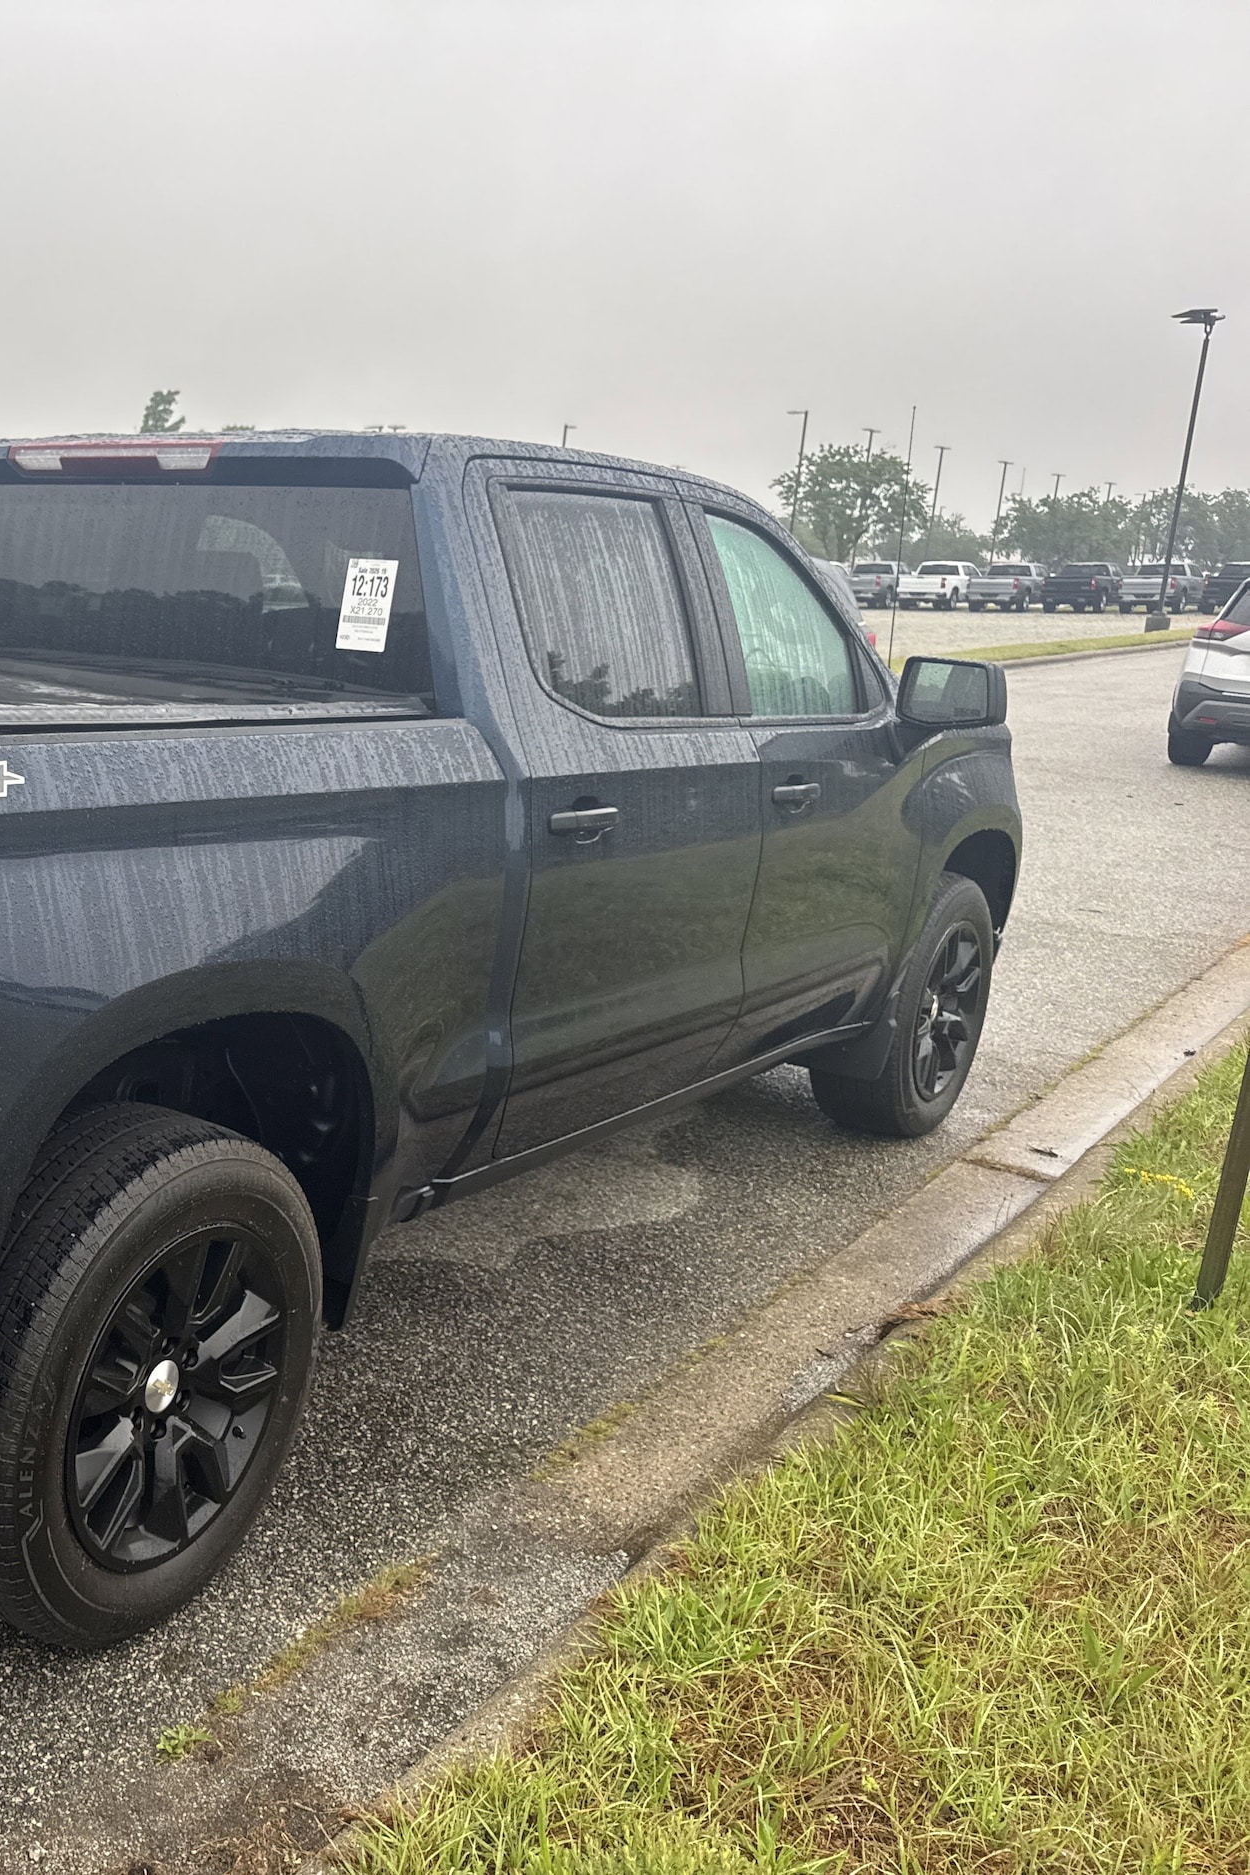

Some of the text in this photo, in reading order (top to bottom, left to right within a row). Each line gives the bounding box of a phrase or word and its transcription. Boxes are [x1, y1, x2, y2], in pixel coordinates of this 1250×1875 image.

[352, 575, 389, 598] 12:173
[358, 598, 378, 607] 2022
[19, 1403, 44, 1517] ALENZA
